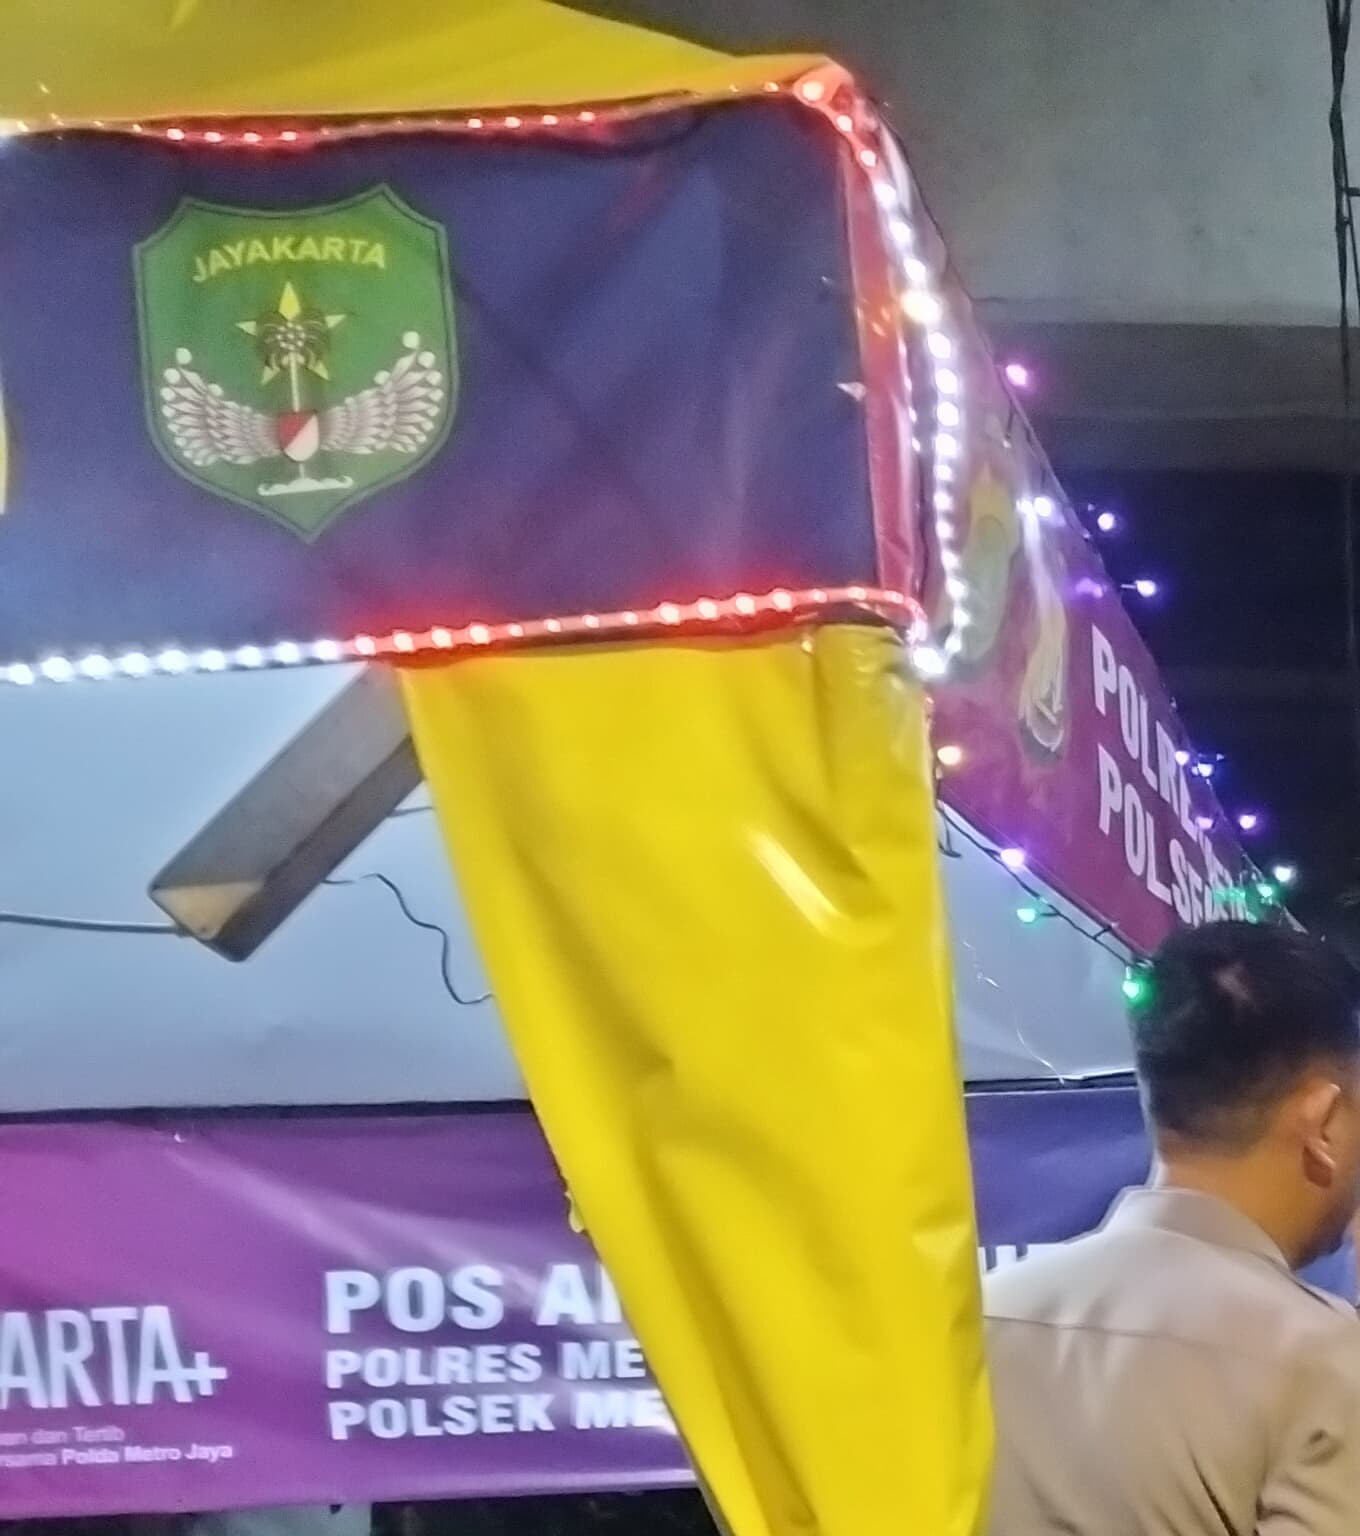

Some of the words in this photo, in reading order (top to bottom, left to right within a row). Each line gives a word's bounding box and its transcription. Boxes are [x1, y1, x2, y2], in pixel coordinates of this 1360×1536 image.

[192, 235, 387, 283] JAYAKARTA
[324, 1265, 503, 1332] POS
[326, 1344, 543, 1389] POLRES
[328, 1394, 556, 1440] POLSEK
[61, 1448, 120, 1466] Polda
[123, 1446, 182, 1462] Metro
[185, 1443, 233, 1464] Jaya
